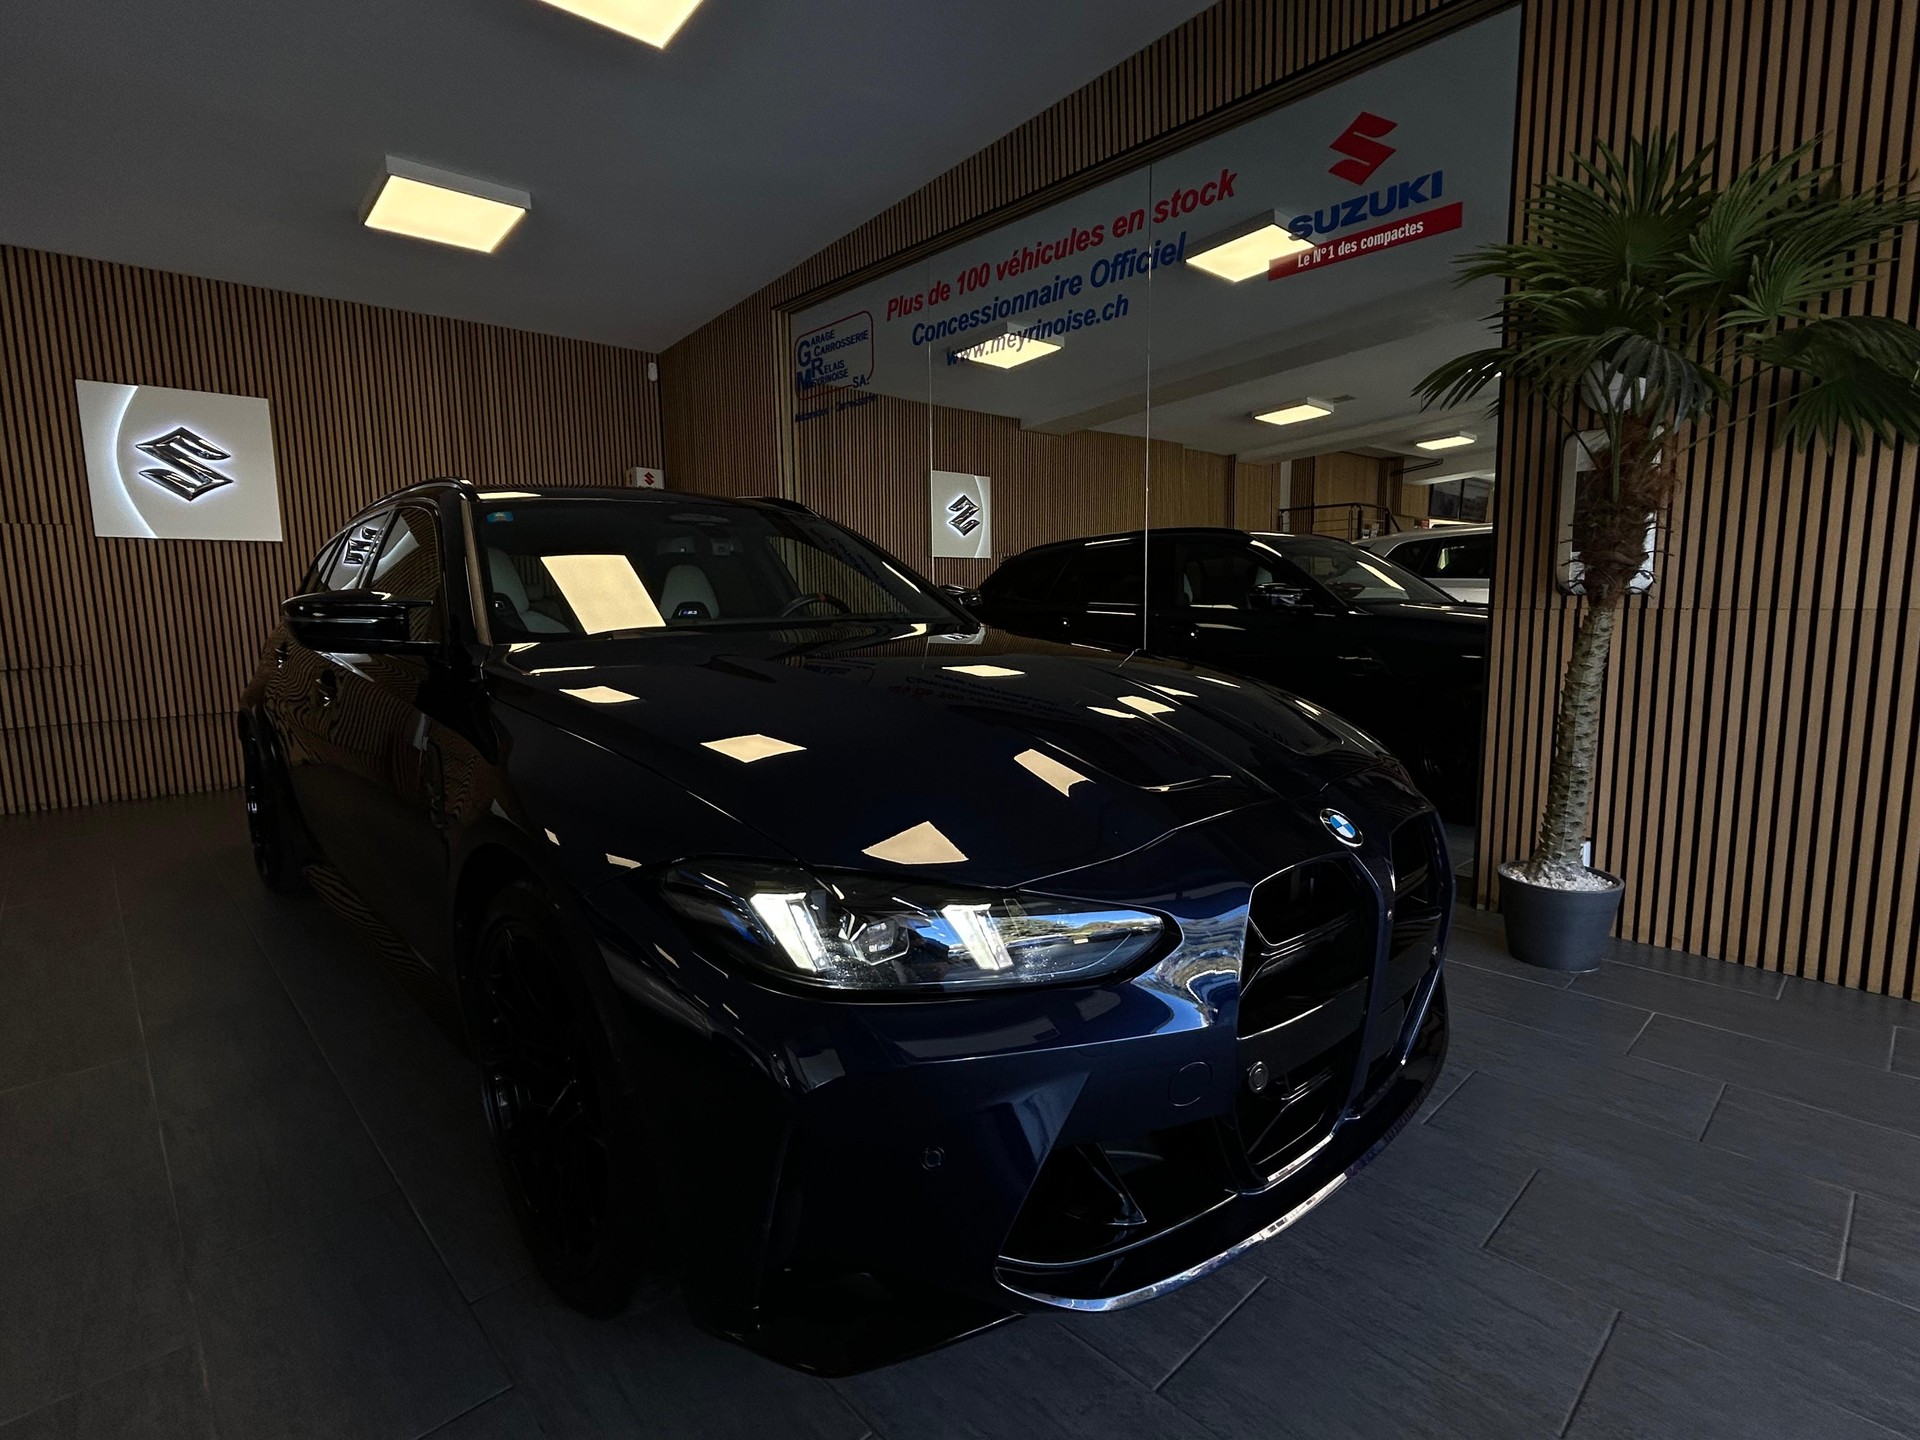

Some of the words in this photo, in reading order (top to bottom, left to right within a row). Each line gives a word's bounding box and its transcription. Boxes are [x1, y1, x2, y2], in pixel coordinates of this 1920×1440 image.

[1287, 170, 1444, 241] SUZUKI
[886, 295, 924, 321] Plus
[927, 281, 951, 306] de
[956, 263, 990, 294] 100
[996, 221, 1104, 281] véhicules
[1112, 208, 1145, 239] en
[1152, 168, 1238, 224] stock
[1297, 254, 1311, 268] Le
[1338, 240, 1358, 257] des
[1360, 221, 1425, 251] compactes
[911, 273, 1083, 346] Concessionnaire
[1090, 231, 1187, 288] Officiel
[814, 329, 869, 357] CARROSSERIE
[945, 294, 1129, 366] www.meyrinoise.ch
